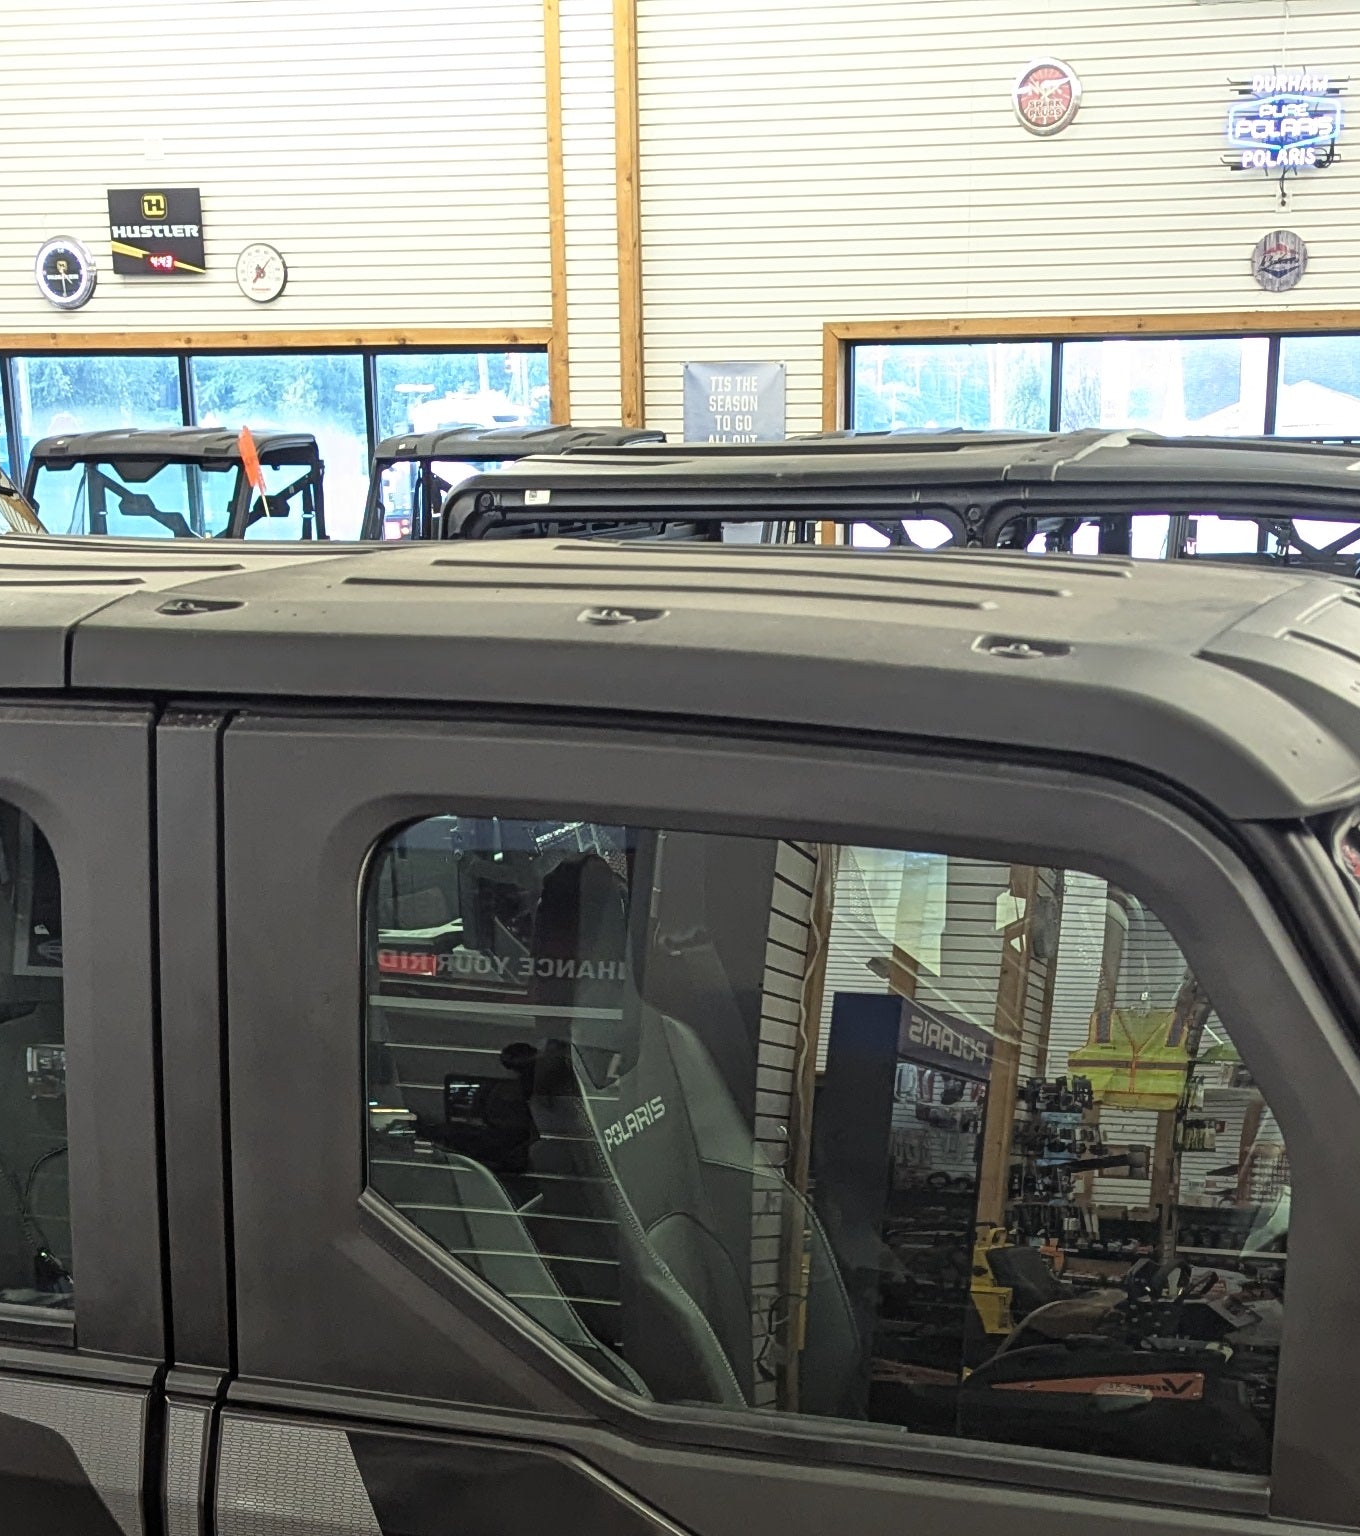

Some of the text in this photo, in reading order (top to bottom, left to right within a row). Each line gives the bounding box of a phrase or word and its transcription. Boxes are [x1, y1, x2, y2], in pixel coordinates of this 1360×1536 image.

[1252, 75, 1328, 92] DURHAM
[1259, 103, 1310, 117] PURE
[1241, 147, 1316, 168] POLARIS
[112, 225, 199, 238] HUSTLER
[710, 376, 758, 392] TIS THE
[709, 395, 758, 412] SEASON
[714, 415, 752, 431] TO GO
[604, 1095, 665, 1153] POLARIS
